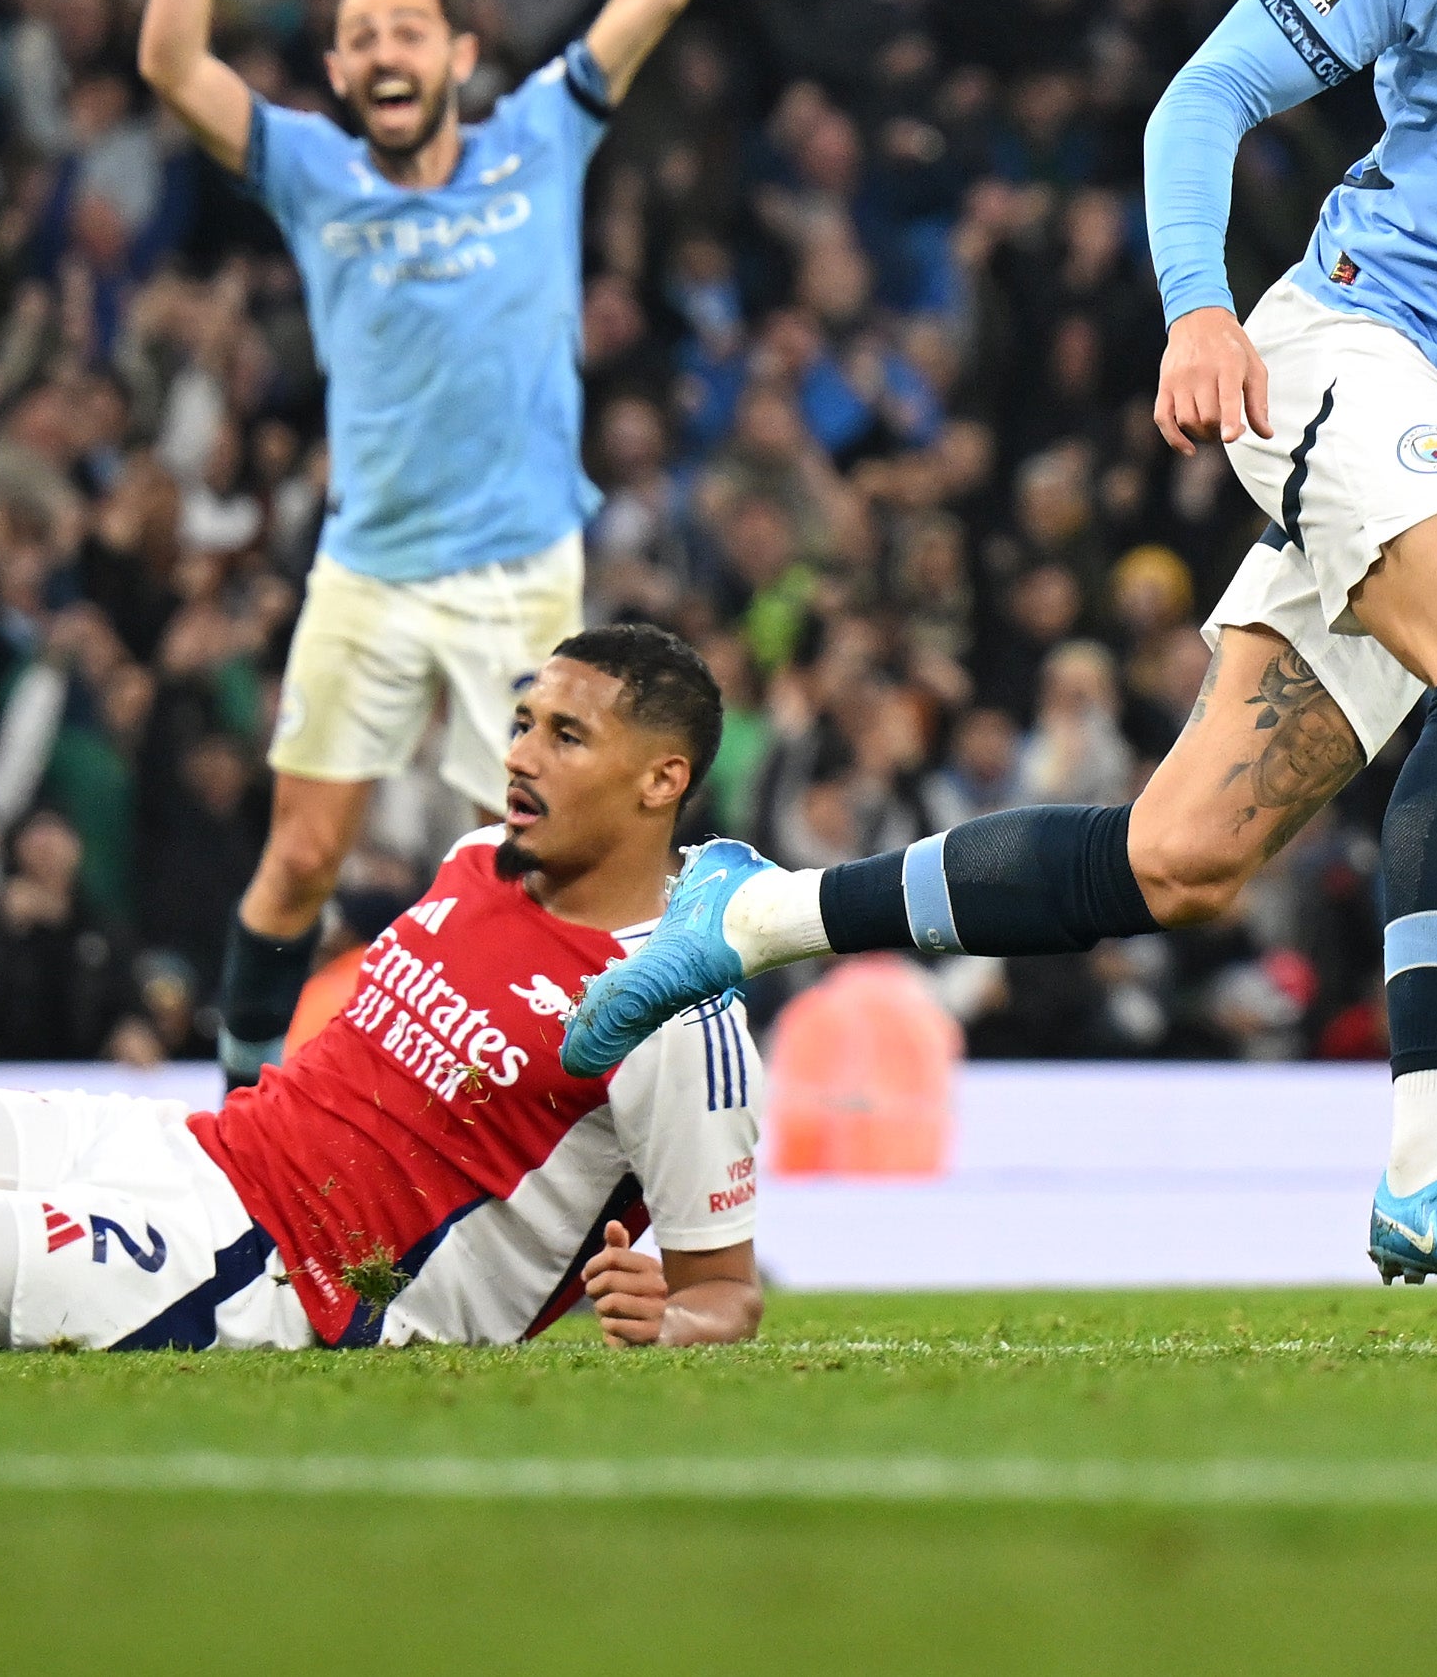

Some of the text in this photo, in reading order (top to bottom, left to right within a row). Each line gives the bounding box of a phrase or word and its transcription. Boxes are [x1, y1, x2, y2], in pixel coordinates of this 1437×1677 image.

[360, 926, 530, 1087] Emirates
[381, 1009, 469, 1102] BETTER
[89, 1213, 167, 1274] 2
